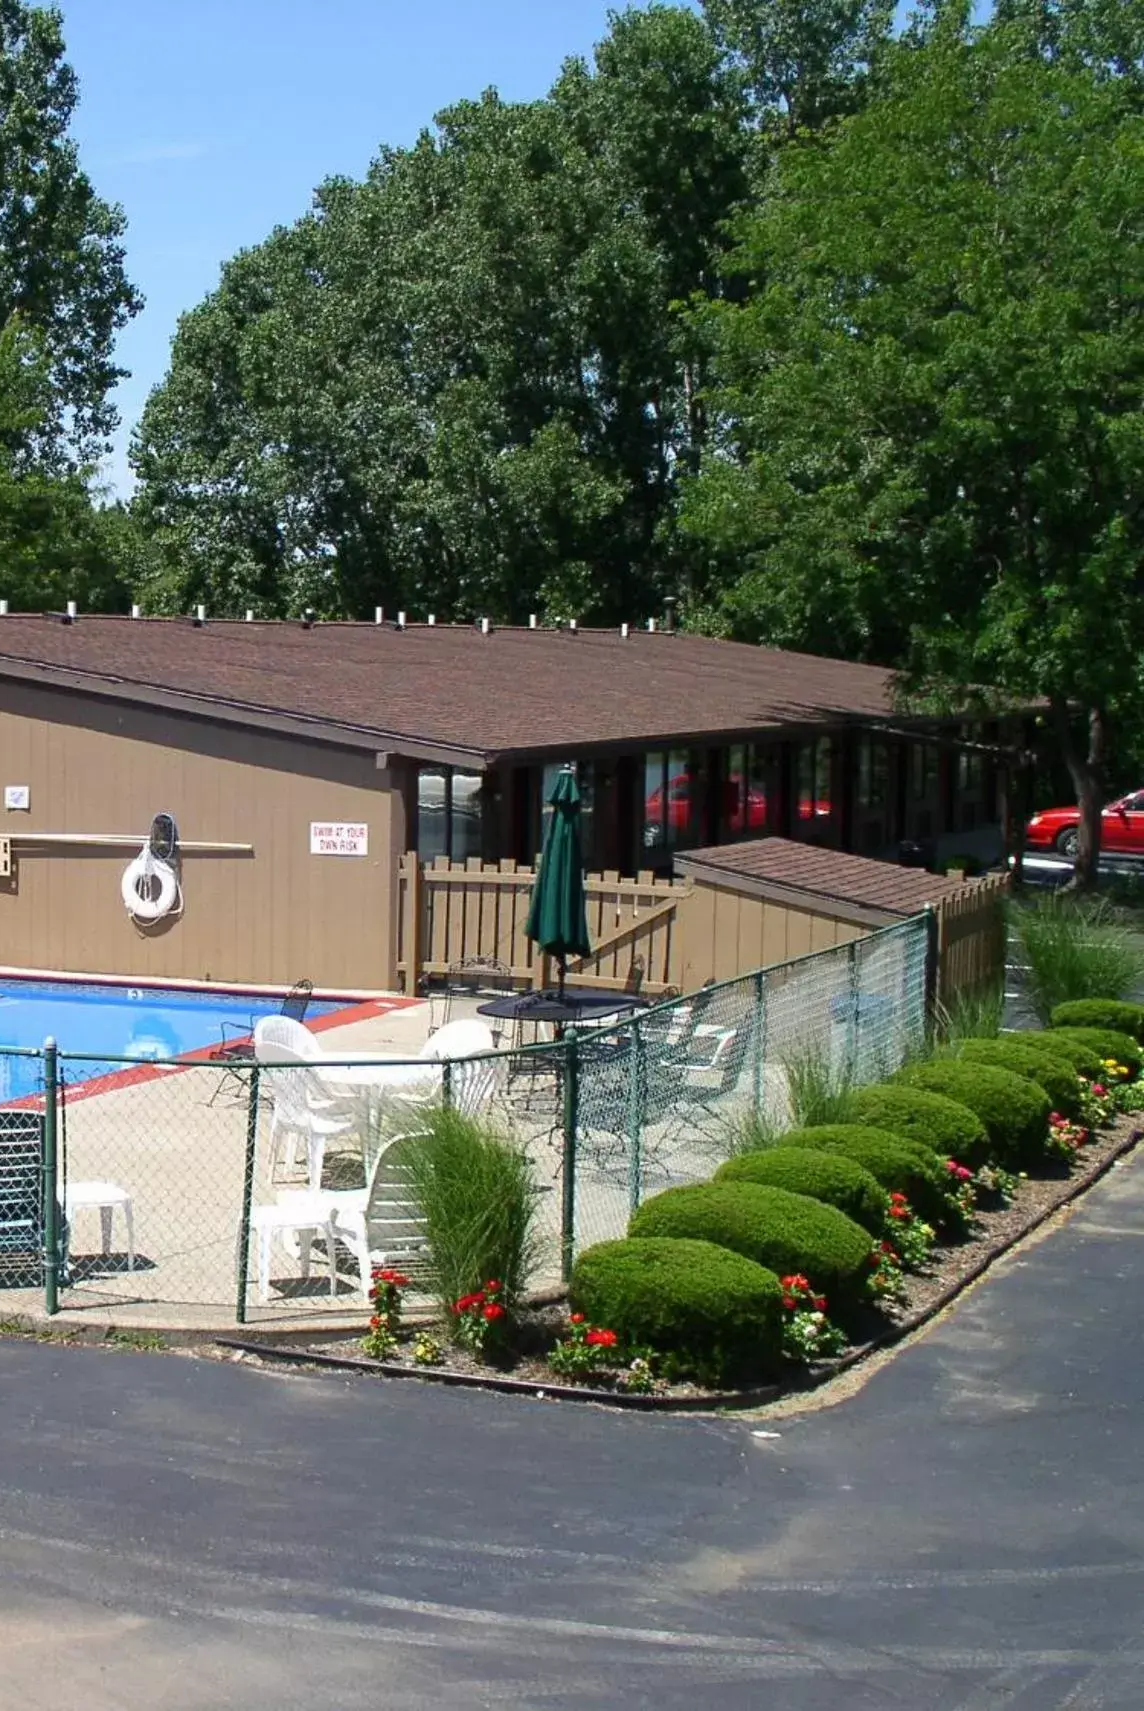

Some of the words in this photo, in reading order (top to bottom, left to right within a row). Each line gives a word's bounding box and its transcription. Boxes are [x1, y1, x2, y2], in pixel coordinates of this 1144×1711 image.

[314, 826, 333, 837] SWIM
[335, 827, 345, 838] AT
[346, 827, 366, 838] YOUR
[319, 839, 337, 851] OWN
[339, 840, 357, 852] RISK
